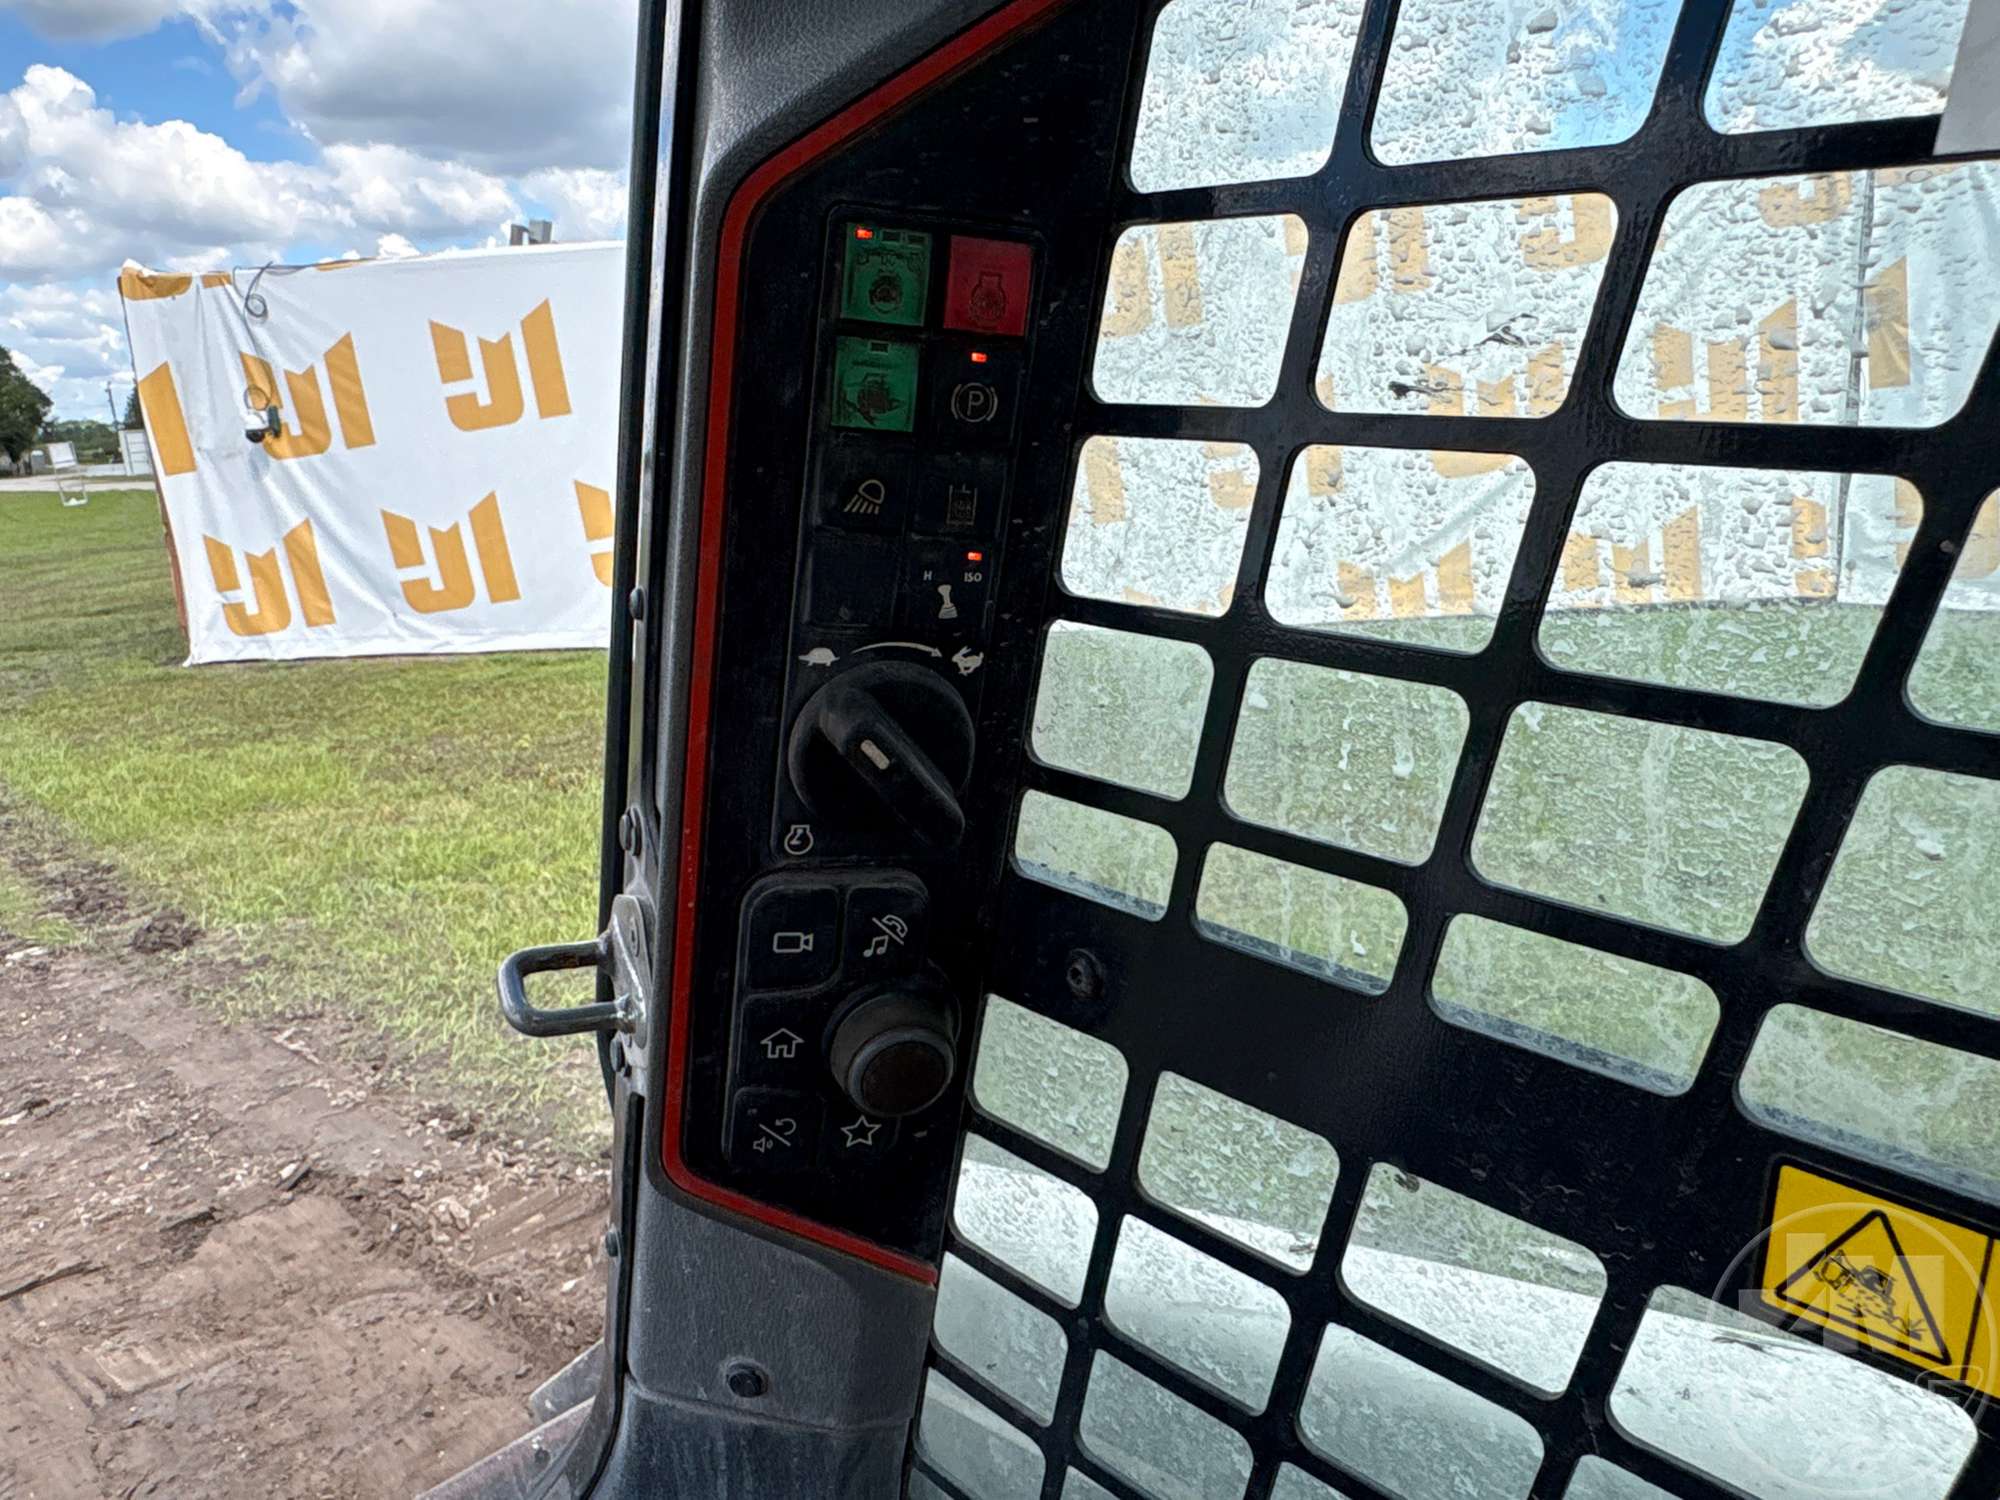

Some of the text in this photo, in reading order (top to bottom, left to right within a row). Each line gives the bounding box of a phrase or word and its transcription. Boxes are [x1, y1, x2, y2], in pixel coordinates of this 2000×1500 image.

[967, 390, 985, 416] P
[922, 570, 933, 582] H
[963, 572, 983, 583] ISO
